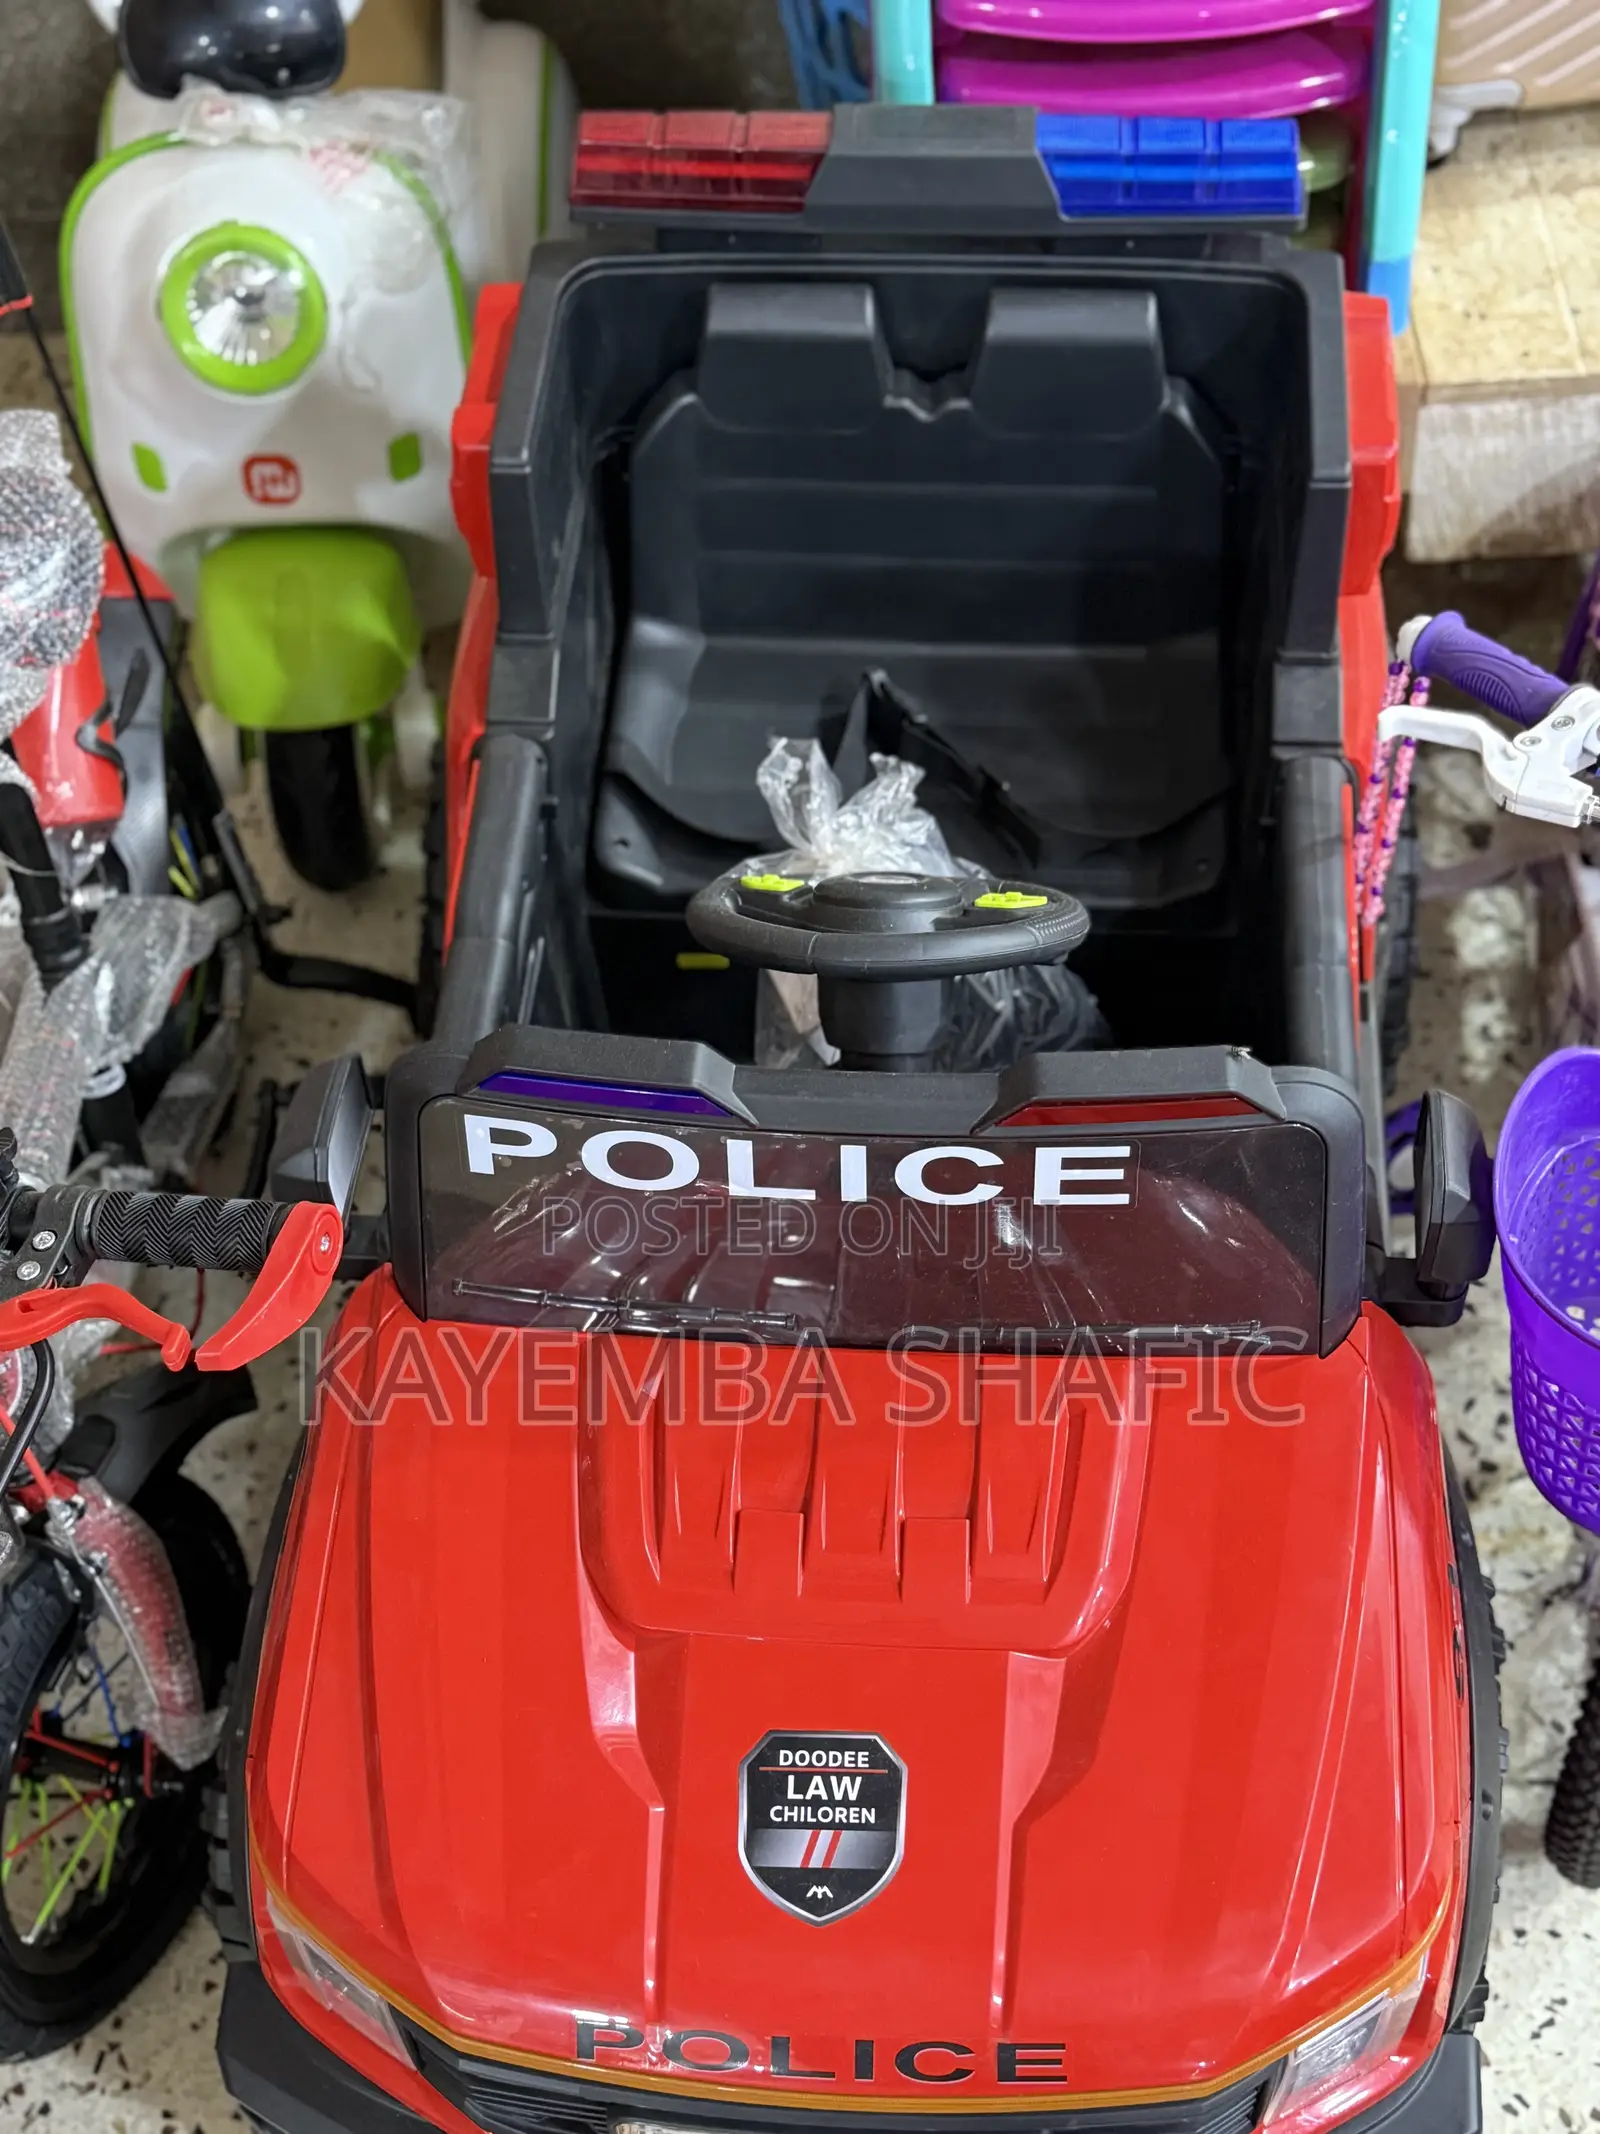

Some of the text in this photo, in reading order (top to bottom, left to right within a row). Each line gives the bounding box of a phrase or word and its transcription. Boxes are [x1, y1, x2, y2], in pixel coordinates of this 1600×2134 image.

[463, 1113, 1132, 1206] POLICE
[778, 1749, 869, 1768] DOODEE
[786, 1774, 863, 1801] LAW
[575, 2012, 1068, 2083] POLICE
